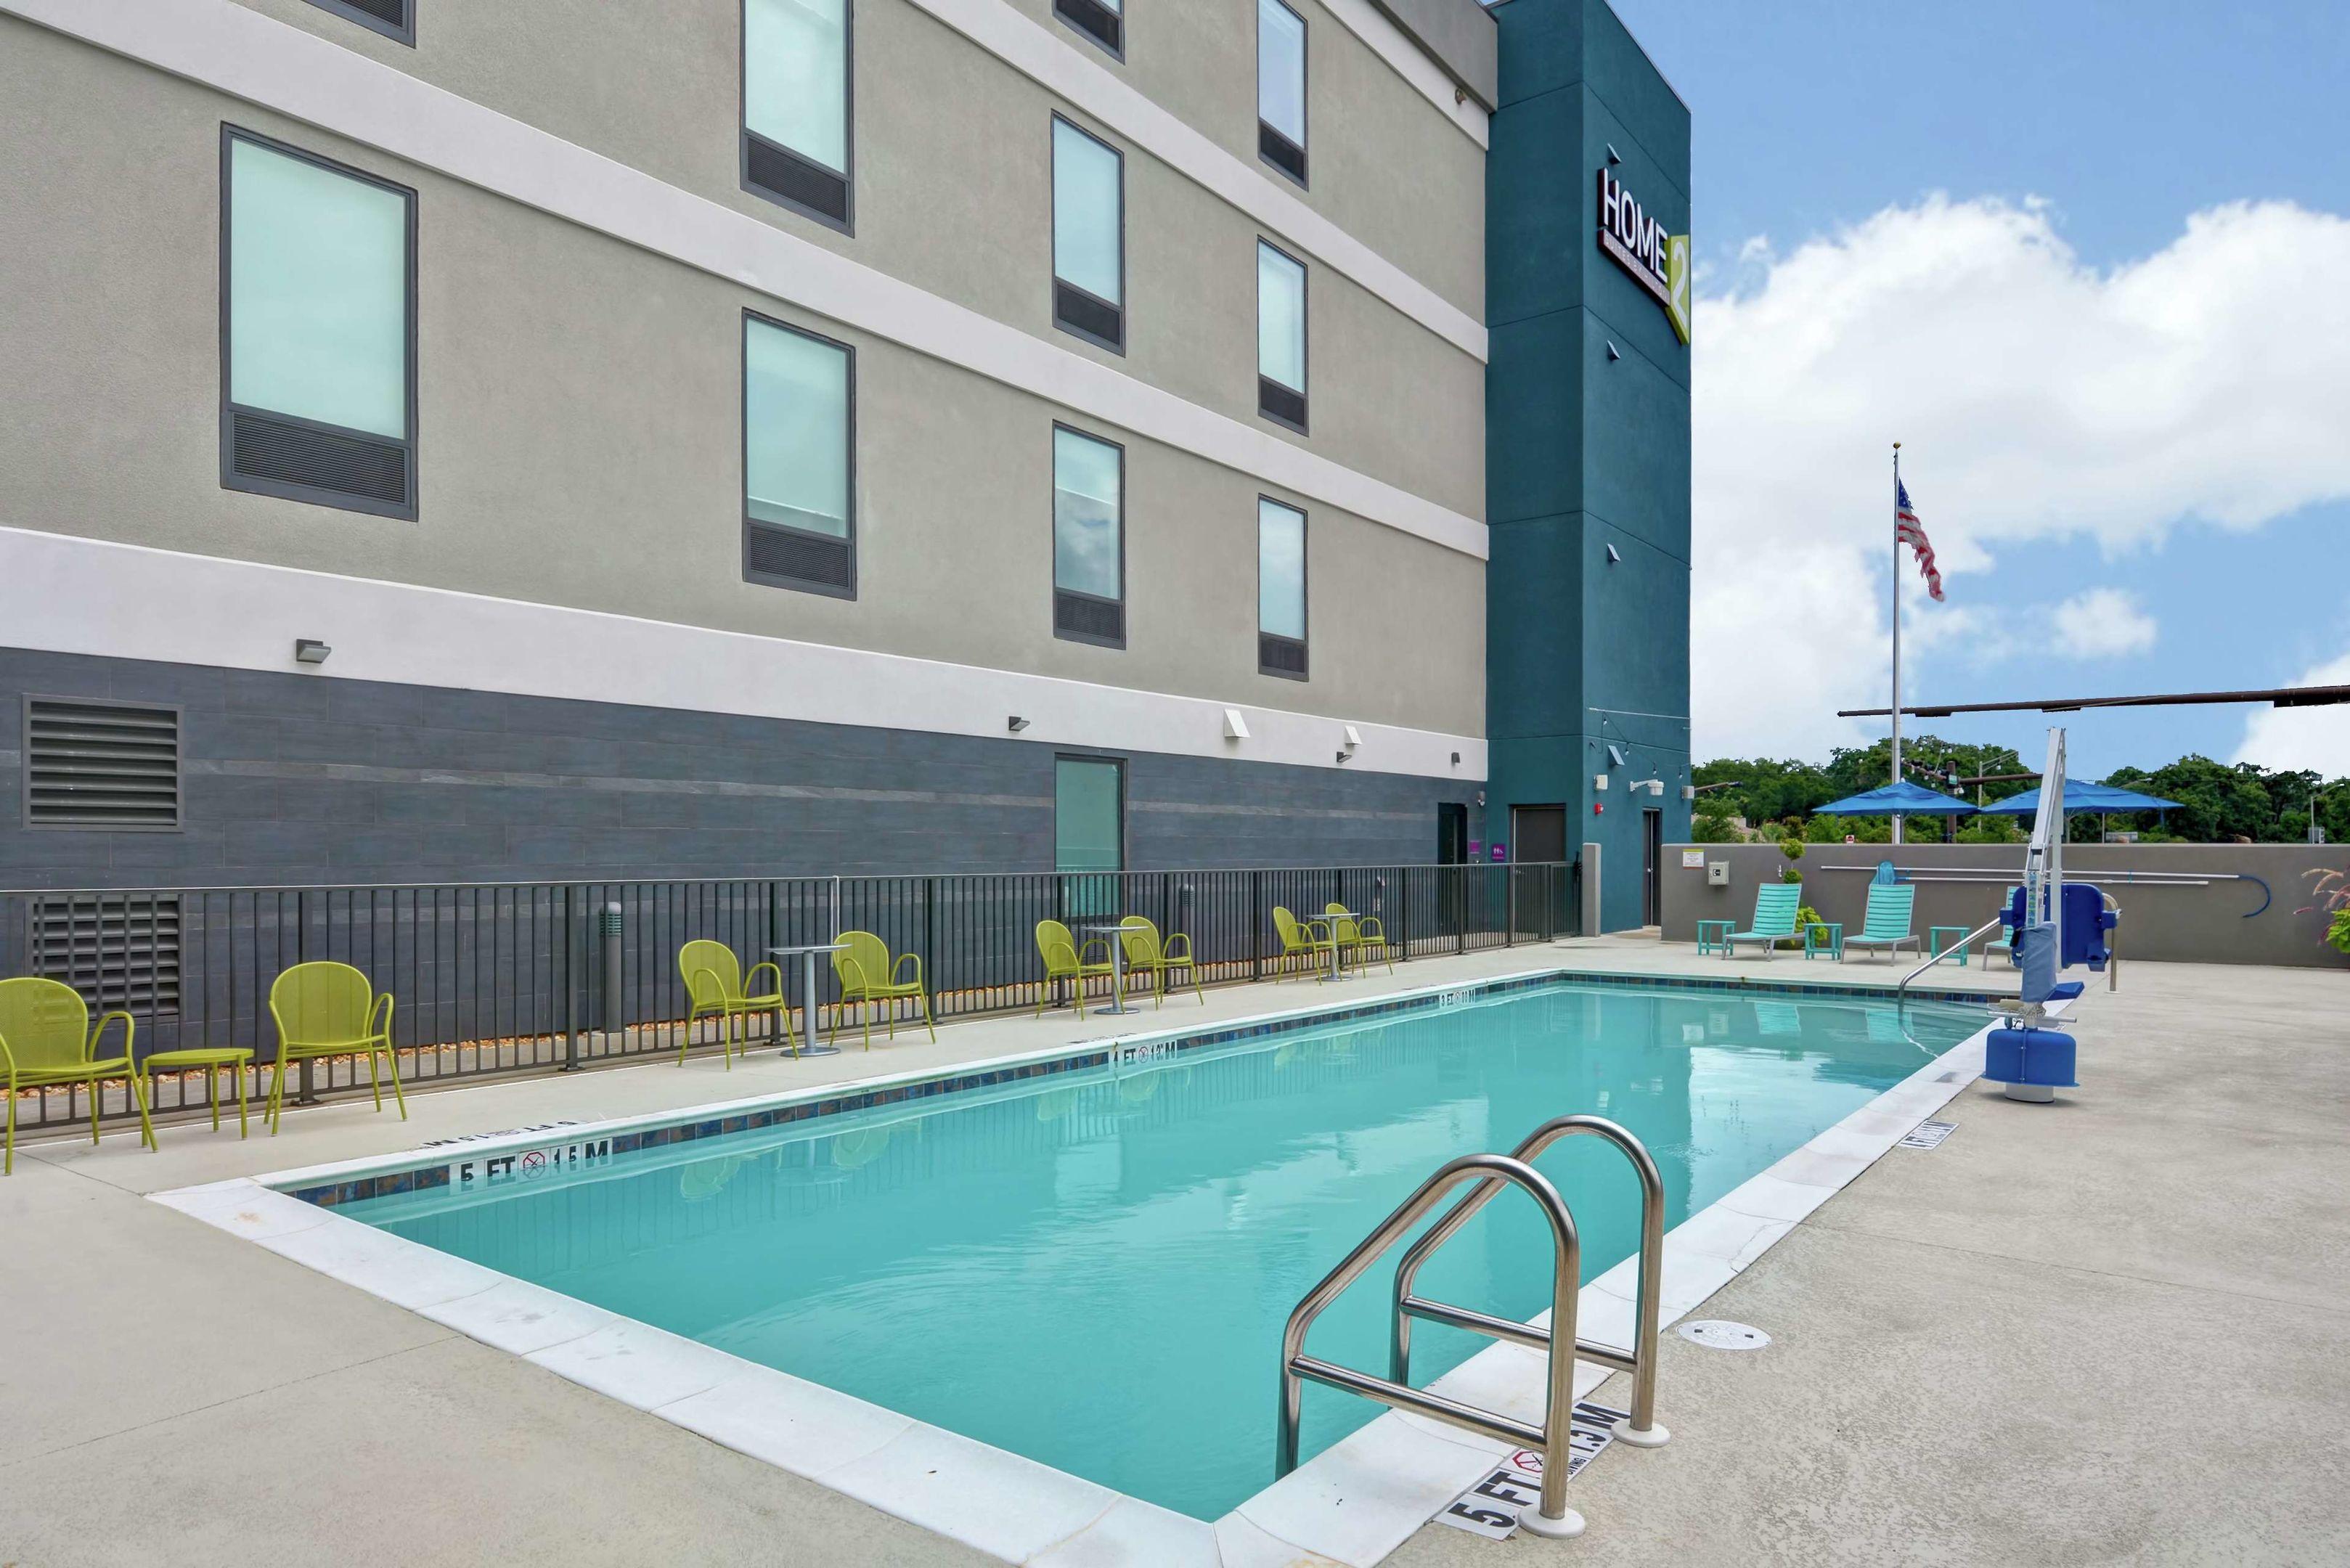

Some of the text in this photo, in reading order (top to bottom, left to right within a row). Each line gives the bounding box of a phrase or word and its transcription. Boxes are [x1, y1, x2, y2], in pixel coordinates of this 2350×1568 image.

[1602, 167, 1688, 330] HOME 2
[1124, 1048, 1136, 1061] FT
[460, 1163, 474, 1182] 5
[487, 1156, 515, 1177] FT
[585, 1140, 608, 1159] M
[1473, 1471, 1541, 1506] FT
[1448, 1502, 1516, 1528] 5
